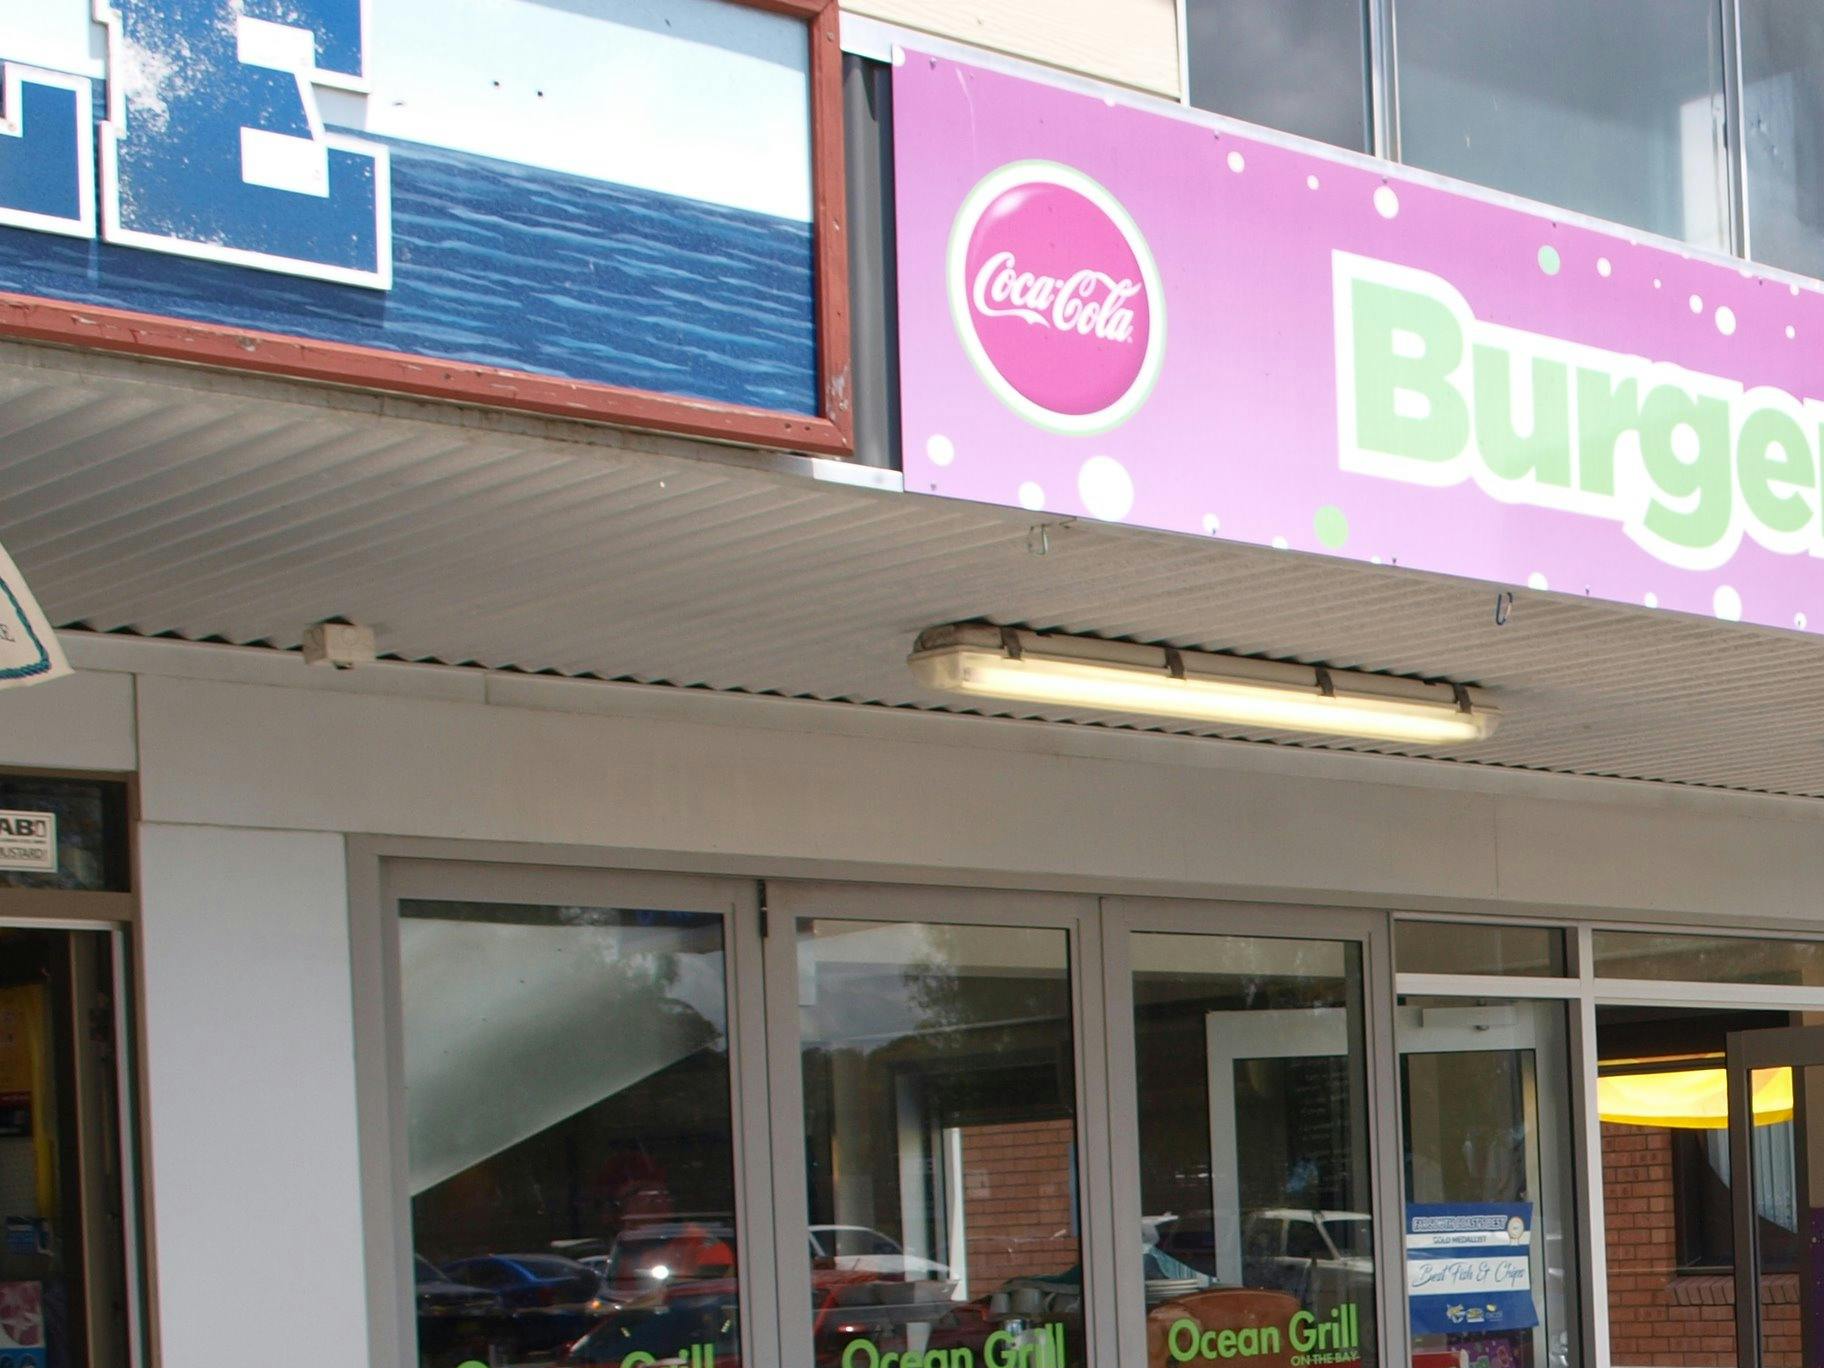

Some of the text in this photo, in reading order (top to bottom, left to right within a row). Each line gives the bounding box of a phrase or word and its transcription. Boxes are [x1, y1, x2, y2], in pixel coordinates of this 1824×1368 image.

[972, 250, 1142, 344] Coca-Cola
[1168, 1303, 1359, 1362] Ocean Grill
[1290, 1354, 1310, 1367] ON
[1312, 1353, 1335, 1365] THE
